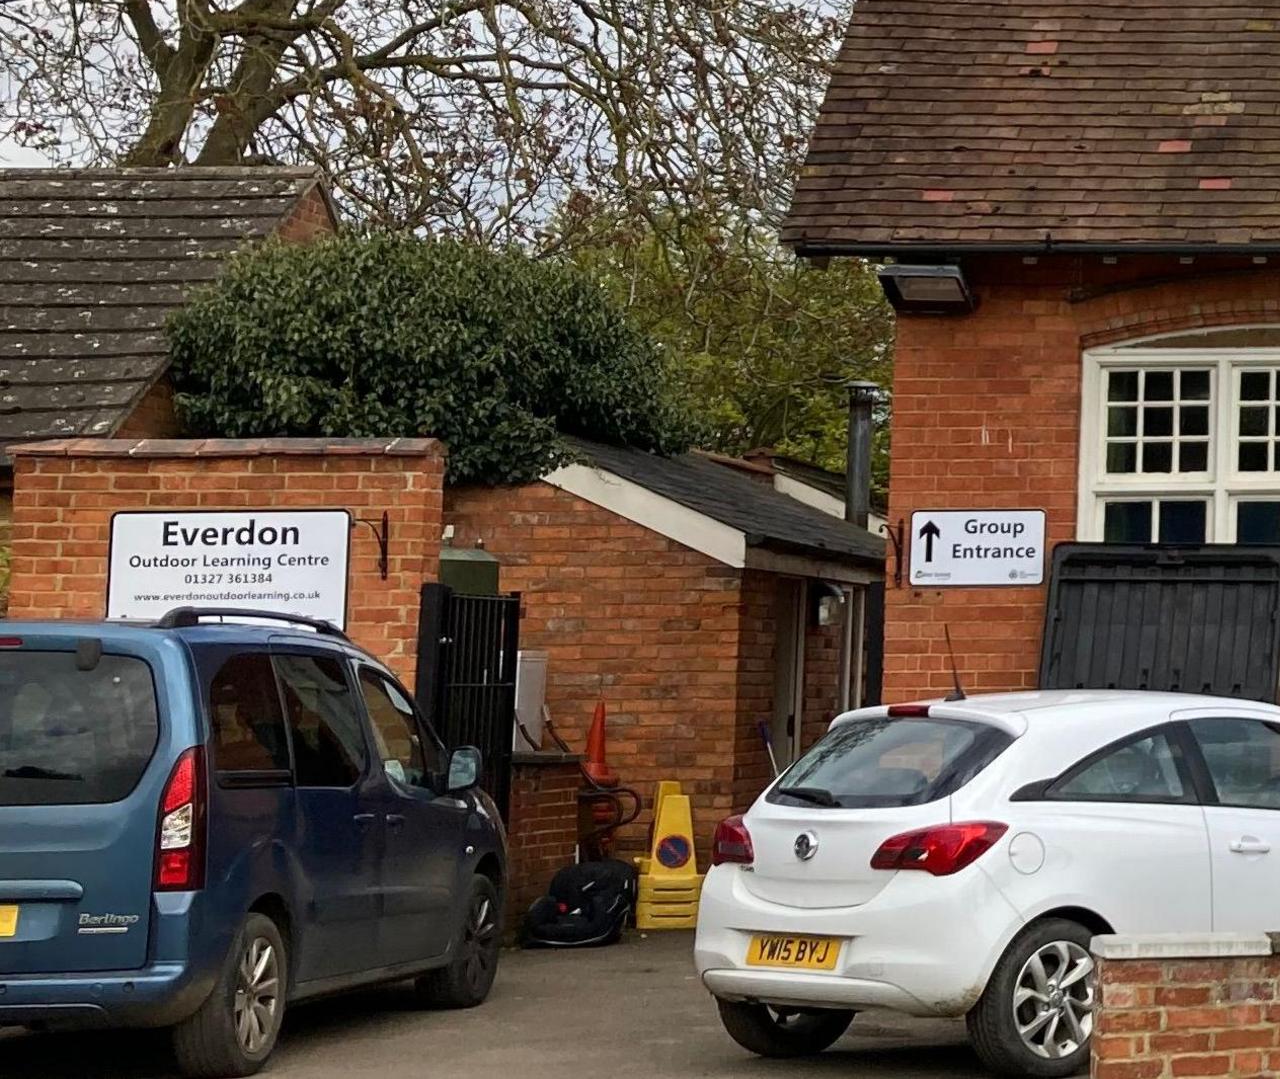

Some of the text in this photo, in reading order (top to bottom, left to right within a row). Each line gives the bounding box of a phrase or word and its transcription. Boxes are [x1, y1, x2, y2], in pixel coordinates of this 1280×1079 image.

[161, 519, 300, 547] Everdon
[964, 519, 1025, 539] Group
[952, 543, 1036, 559] Entrance
[129, 553, 330, 570] Outdoor Learning Centre
[184, 572, 273, 585] 01327 361384
[133, 590, 321, 602] www.everdonoutdoorlearning.co.uk
[758, 936, 831, 963] YW15 BYJ
